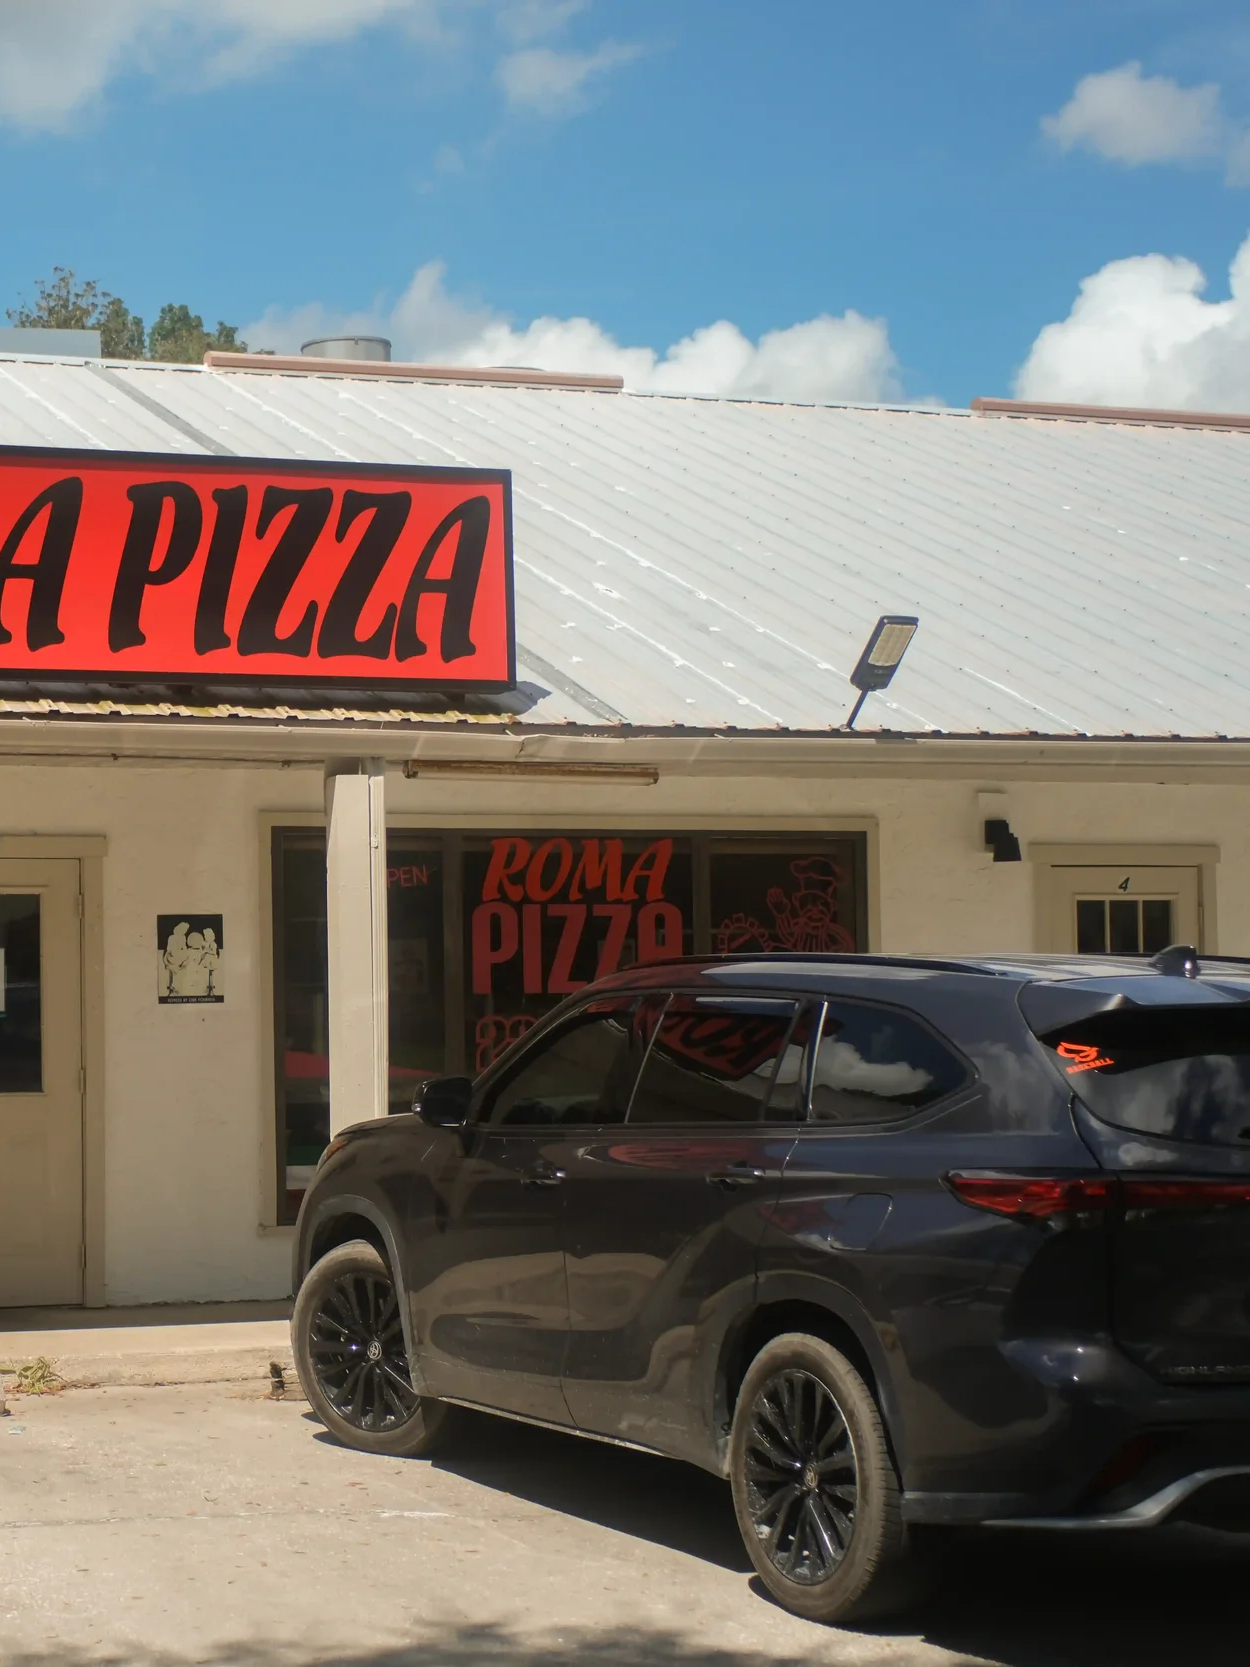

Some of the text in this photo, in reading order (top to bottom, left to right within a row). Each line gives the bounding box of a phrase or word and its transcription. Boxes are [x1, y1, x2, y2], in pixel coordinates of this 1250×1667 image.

[108, 481, 491, 663] PIZZA
[387, 865, 429, 888] PEN
[481, 837, 674, 902] ROMA
[1118, 876, 1131, 892] 4
[472, 901, 683, 994] PIZZA
